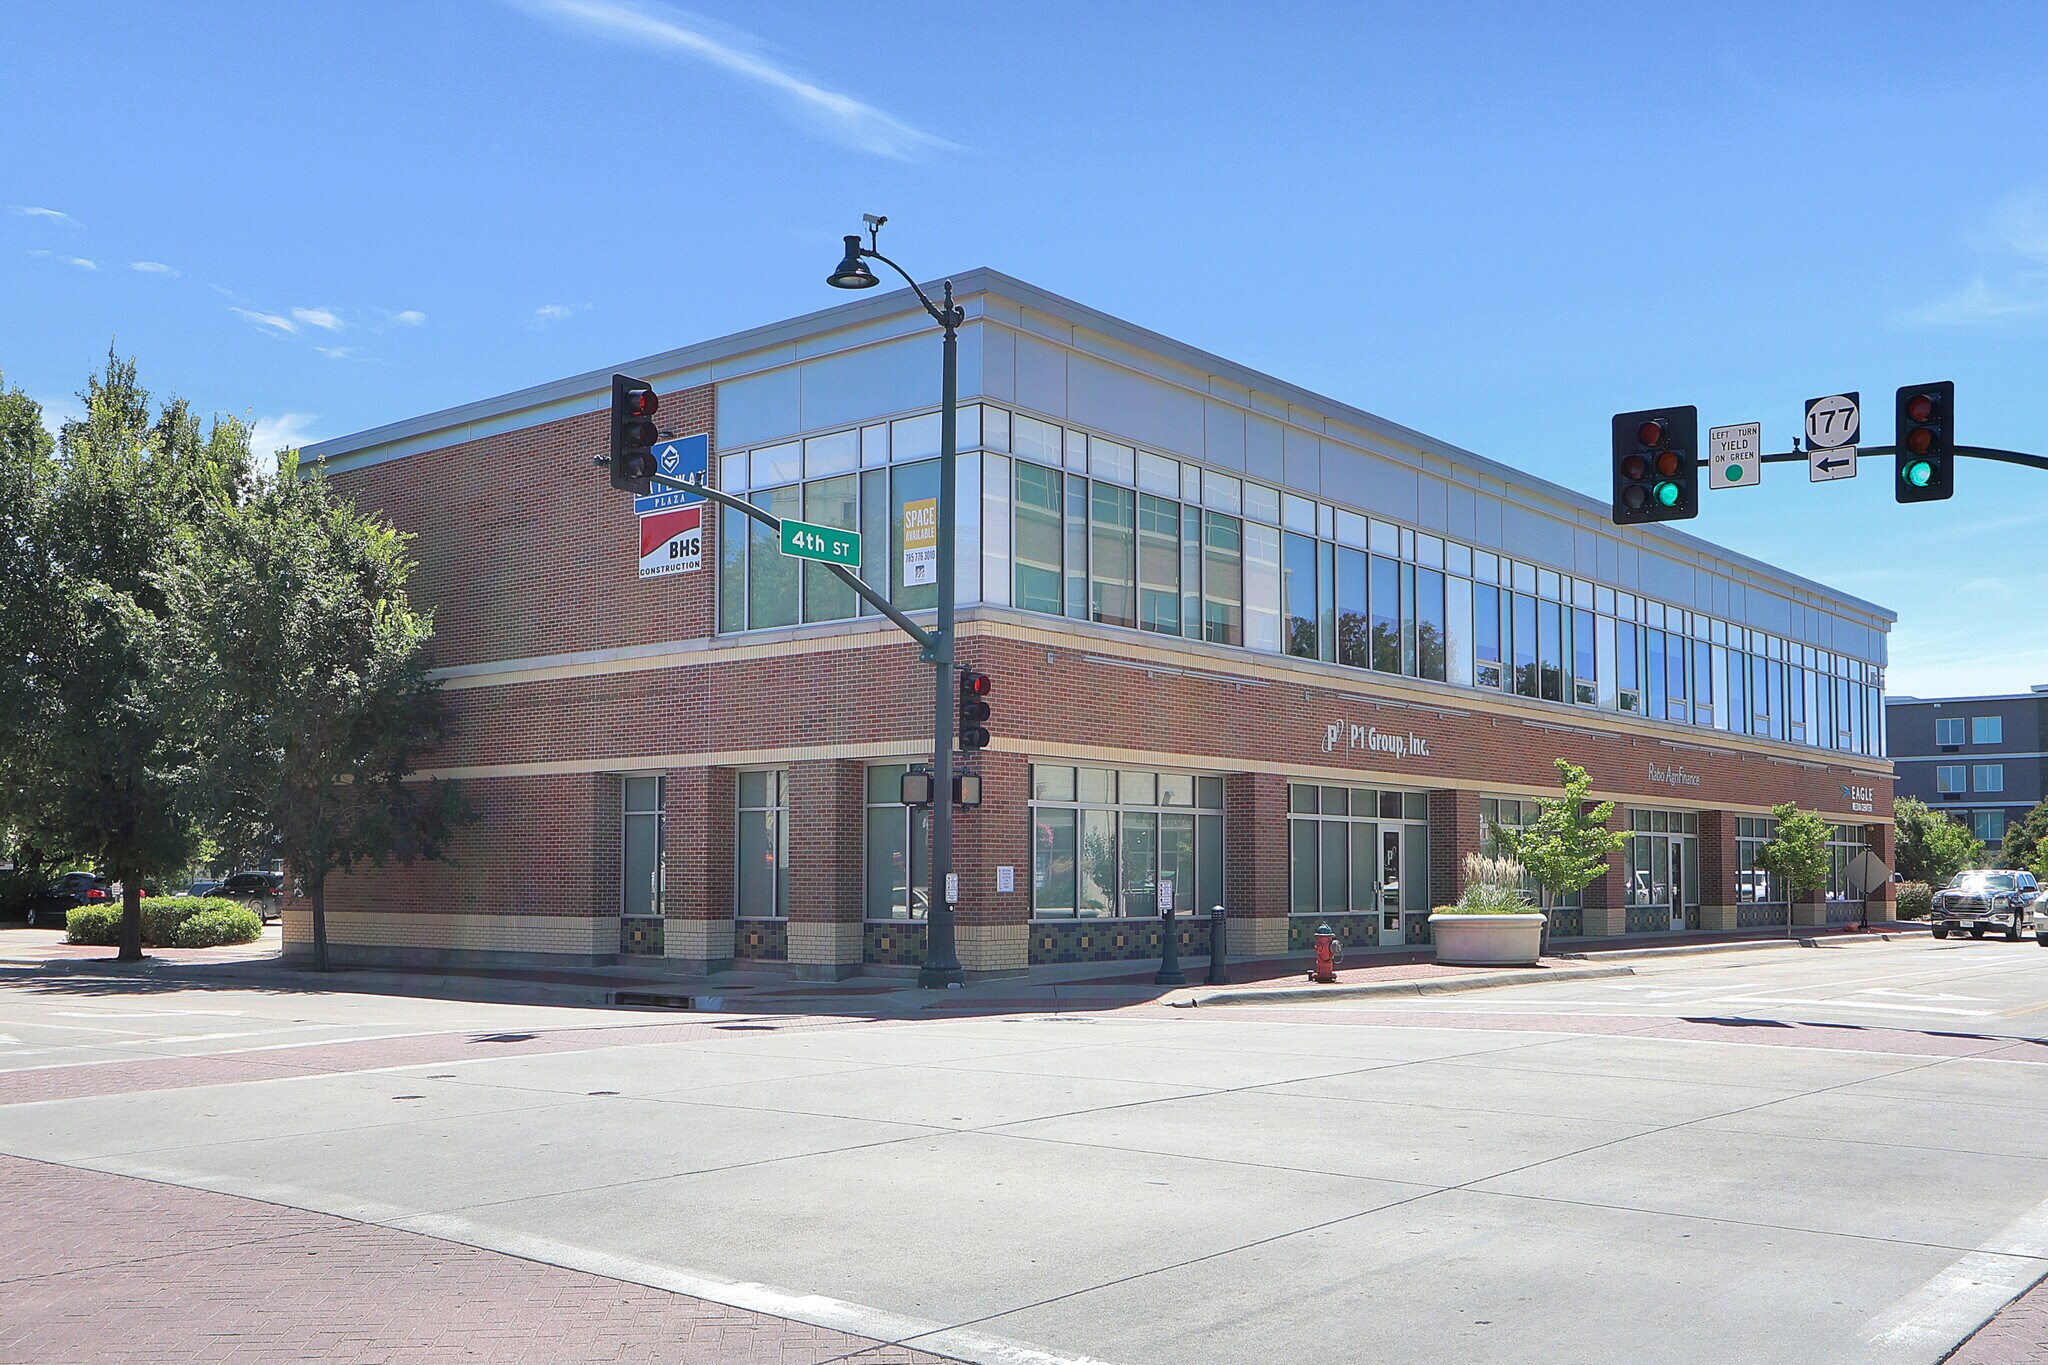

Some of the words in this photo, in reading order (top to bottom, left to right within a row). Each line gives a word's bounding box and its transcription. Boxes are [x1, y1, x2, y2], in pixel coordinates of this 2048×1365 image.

[1810, 406, 1855, 436] 177
[1712, 431, 1729, 440] LEFT
[1738, 428, 1757, 437] TURN
[1721, 440, 1748, 451] YIELD
[1730, 452, 1754, 461] GREEN
[655, 494, 685, 507] PLAZA
[905, 507, 935, 529] SPACE
[905, 527, 935, 542] AVAILABLE
[669, 537, 700, 560] BHS
[792, 531, 825, 553] 4th
[833, 541, 850, 557] ST
[640, 560, 701, 576] CONSTRUCTION
[1351, 724, 1364, 749] P1
[1368, 727, 1407, 759] Group,
[1409, 732, 1430, 756] Inc.
[1649, 762, 1665, 782] Rabo
[1851, 785, 1873, 801] EAGLE
